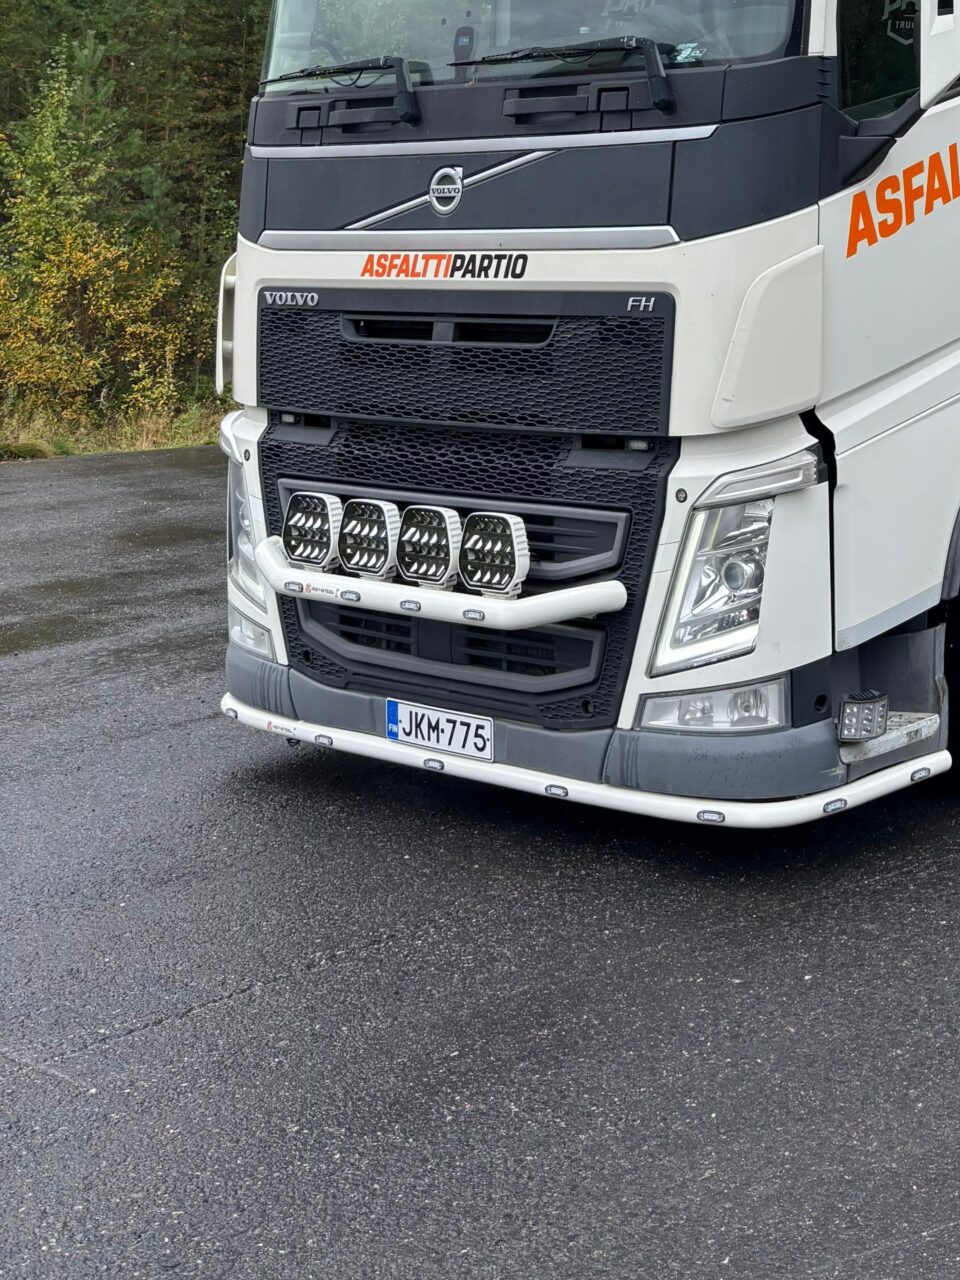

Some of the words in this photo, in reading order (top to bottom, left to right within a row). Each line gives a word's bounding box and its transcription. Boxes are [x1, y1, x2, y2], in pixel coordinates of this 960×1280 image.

[895, 20, 914, 29] TRU
[431, 187, 461, 195] VOLVO
[360, 253, 529, 279] ASFALTTIPARTIO
[264, 291, 319, 306] VOLVO
[626, 296, 656, 312] FH
[402, 710, 487, 753] JKM-775
